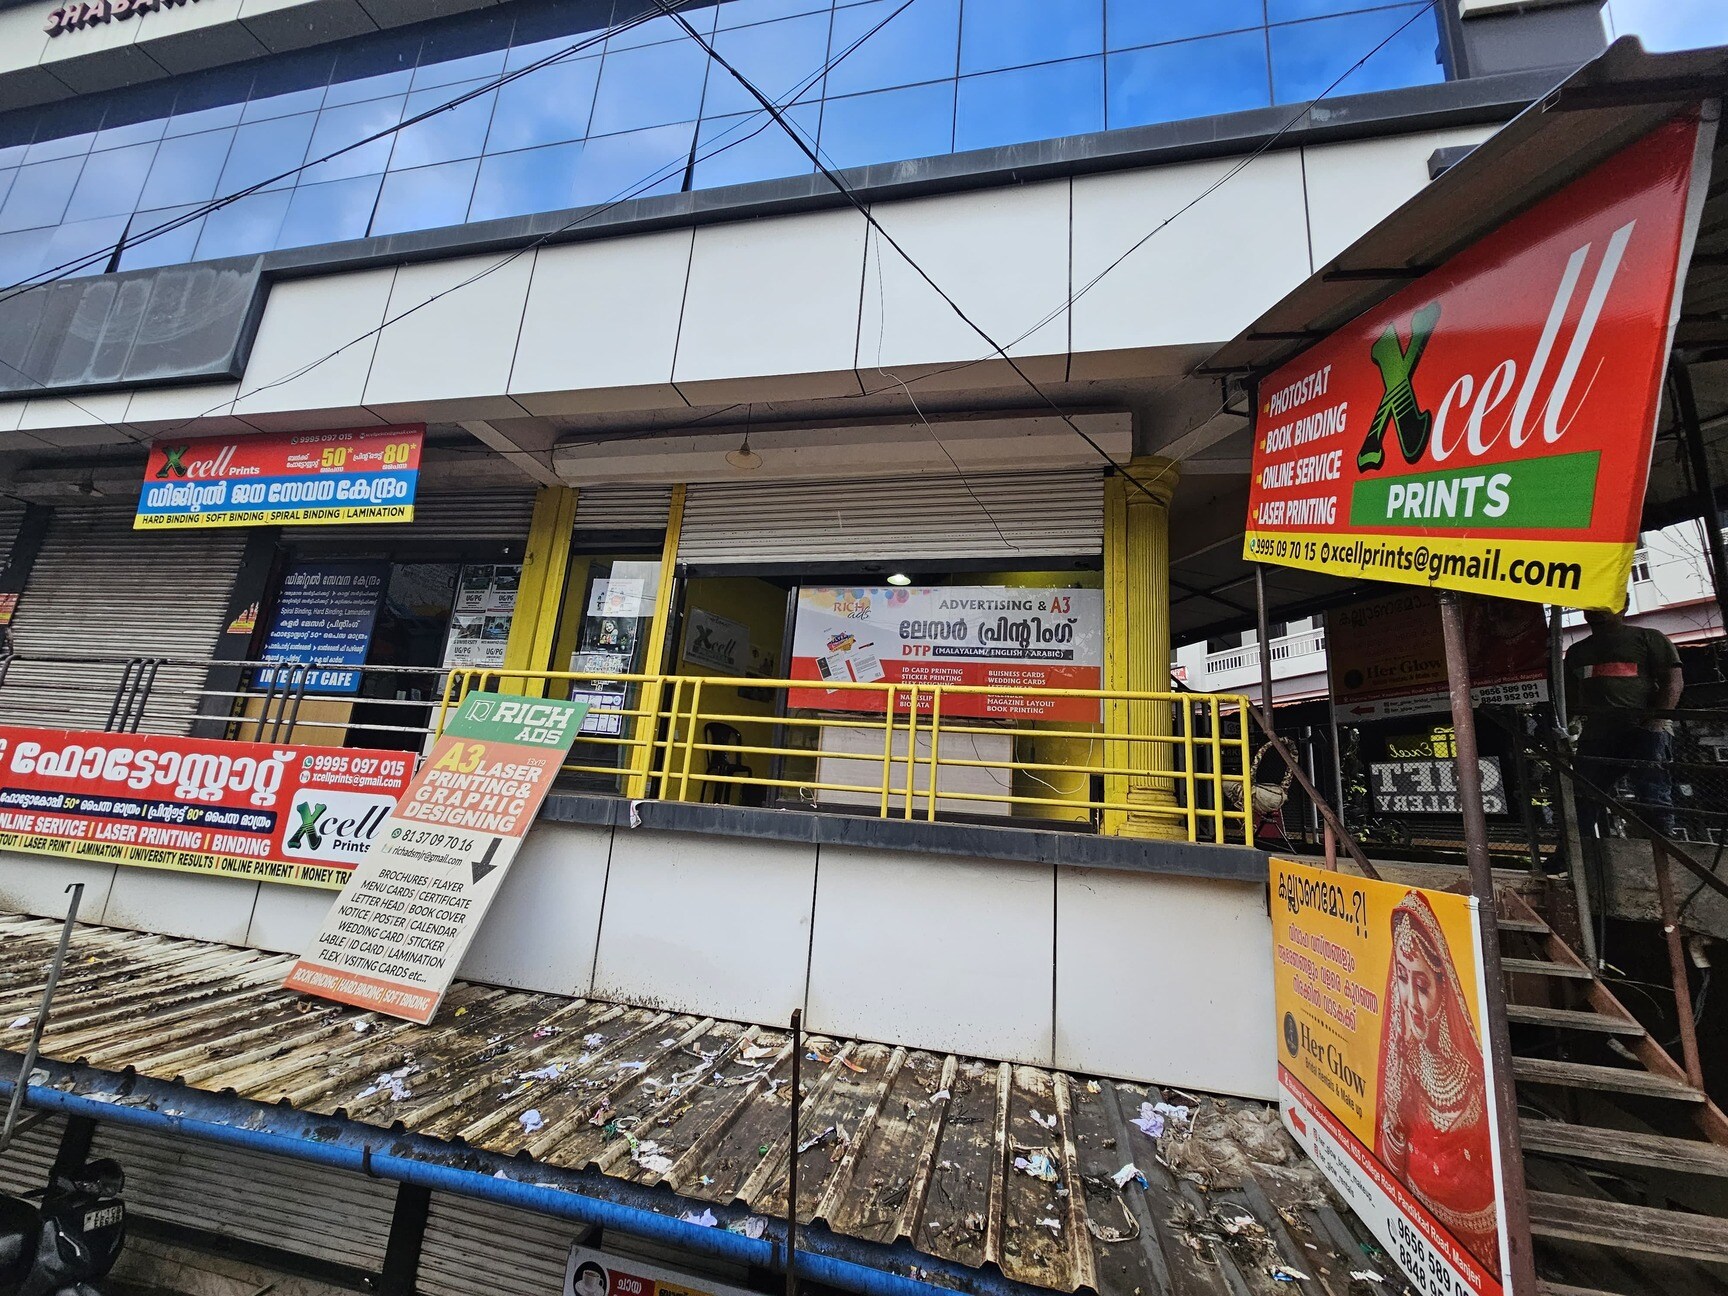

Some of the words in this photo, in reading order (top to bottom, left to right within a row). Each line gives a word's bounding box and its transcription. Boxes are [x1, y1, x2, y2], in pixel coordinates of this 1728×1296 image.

[1357, 217, 1637, 475] Xcell
[1269, 364, 1332, 418] PHOTOSTAT
[1265, 422, 1294, 454] BOOK
[1294, 401, 1348, 447] BINDING
[156, 445, 237, 478] Xcell
[229, 466, 260, 476] Prints
[1262, 460, 1294, 490] ONLINE
[1295, 450, 1343, 486] SERVICE
[147, 480, 227, 512] ഡിജിറ്റൽ
[231, 483, 266, 504] ജന
[268, 480, 335, 503] സേവന
[336, 478, 407, 504] കേന്ദ്രം
[1258, 501, 1285, 525] LASER
[1286, 496, 1337, 525] PRINTING
[1386, 473, 1512, 520] PRINTS
[142, 514, 164, 524] HARD
[166, 513, 199, 524] BINDING
[205, 512, 228, 523] SOFT
[230, 511, 264, 522] BINDING
[270, 510, 300, 521] SPIRAL
[303, 509, 340, 519] BINDING
[346, 507, 405, 519] LAMINATION
[1255, 538, 1274, 556] 9995
[1276, 540, 1288, 558] 09
[1289, 541, 1301, 559] 70
[1304, 542, 1316, 561] 15
[1330, 541, 1582, 590] xcellprints@gmail.com
[939, 600, 1033, 611] ADVERTISING
[1037, 601, 1047, 611] &
[1050, 596, 1071, 614] A3
[899, 617, 968, 641] ലേസർ
[902, 644, 931, 656] DTP
[991, 649, 1022, 657] ENGLISH
[320, 671, 353, 687] CAFE
[901, 673, 927, 681] STICKER
[929, 674, 962, 682] PRINTING
[988, 670, 1020, 678] BUISNESS
[1021, 671, 1045, 679] CARDS
[988, 677, 1021, 685] WEDDING
[1521, 683, 1538, 691] 091
[492, 702, 575, 729] RICH
[987, 698, 1024, 706] MAGAZINE
[1026, 700, 1056, 708] LAYOUT
[1009, 706, 1044, 714] PRINTING
[514, 727, 563, 745] ADS
[314, 755, 349, 771] 9995
[350, 758, 379, 775] 097
[380, 760, 405, 777] 015
[433, 742, 486, 774] A3
[474, 760, 542, 783] LASER
[311, 771, 402, 788] xcellprints@gmail.com
[403, 801, 517, 833] DESIGNING
[415, 786, 525, 818] GRAPHIC
[35, 816, 88, 838] SERVICE
[95, 823, 138, 842] LASER
[138, 826, 202, 850] PRINTING
[212, 834, 271, 857] BINDING
[287, 801, 391, 851] Xcell
[415, 831, 431, 844] 37
[429, 833, 444, 847] 09
[443, 835, 460, 849] 70
[458, 839, 475, 852] 16
[23, 836, 48, 850] LASER
[48, 839, 71, 853] PRINT
[76, 843, 123, 858] LAMINATION
[130, 848, 177, 864] UNIVERSITY
[178, 853, 214, 869] RESULTS
[221, 858, 252, 874] ONLINE
[253, 862, 294, 878] PAYMENT
[300, 867, 333, 883] MONEY
[333, 839, 371, 853] Prints
[361, 880, 387, 892] MENU
[386, 885, 415, 899] CARDS
[418, 891, 472, 910] CERTIFICATE
[378, 868, 429, 886] BROCHURES
[432, 878, 464, 893] FLAYER
[338, 905, 370, 920] NOTICE
[372, 912, 407, 928] POSTER
[409, 920, 458, 938] CALENDAR
[351, 892, 382, 907] LETTER
[380, 899, 405, 912] HEAD
[408, 904, 437, 918] BOOK
[435, 910, 466, 924] COVER
[319, 932, 346, 948] LABLE
[348, 938, 358, 949] ID
[359, 941, 385, 956] CARD
[388, 948, 446, 968] LAMINATION
[338, 920, 378, 939] WEDDING
[378, 930, 405, 944] CARD
[407, 935, 445, 952] STICKER
[318, 949, 341, 963] FLEX
[378, 963, 409, 978] CARDS
[292, 968, 313, 982] BOOK
[311, 973, 337, 990] BINDING
[338, 978, 357, 993] HARD
[356, 983, 384, 1000] BINDING
[384, 989, 403, 1003] SOFT
[401, 994, 430, 1011] BINDING
[1300, 1021, 1325, 1064] Her
[1327, 1043, 1367, 1098] Glow
[1397, 1217, 1425, 1262] 9656
[1428, 1250, 1451, 1292] 589
[1399, 1243, 1427, 1291] 8848
[1430, 1224, 1452, 1260] Road,
[1452, 1247, 1482, 1290] Manjeri
